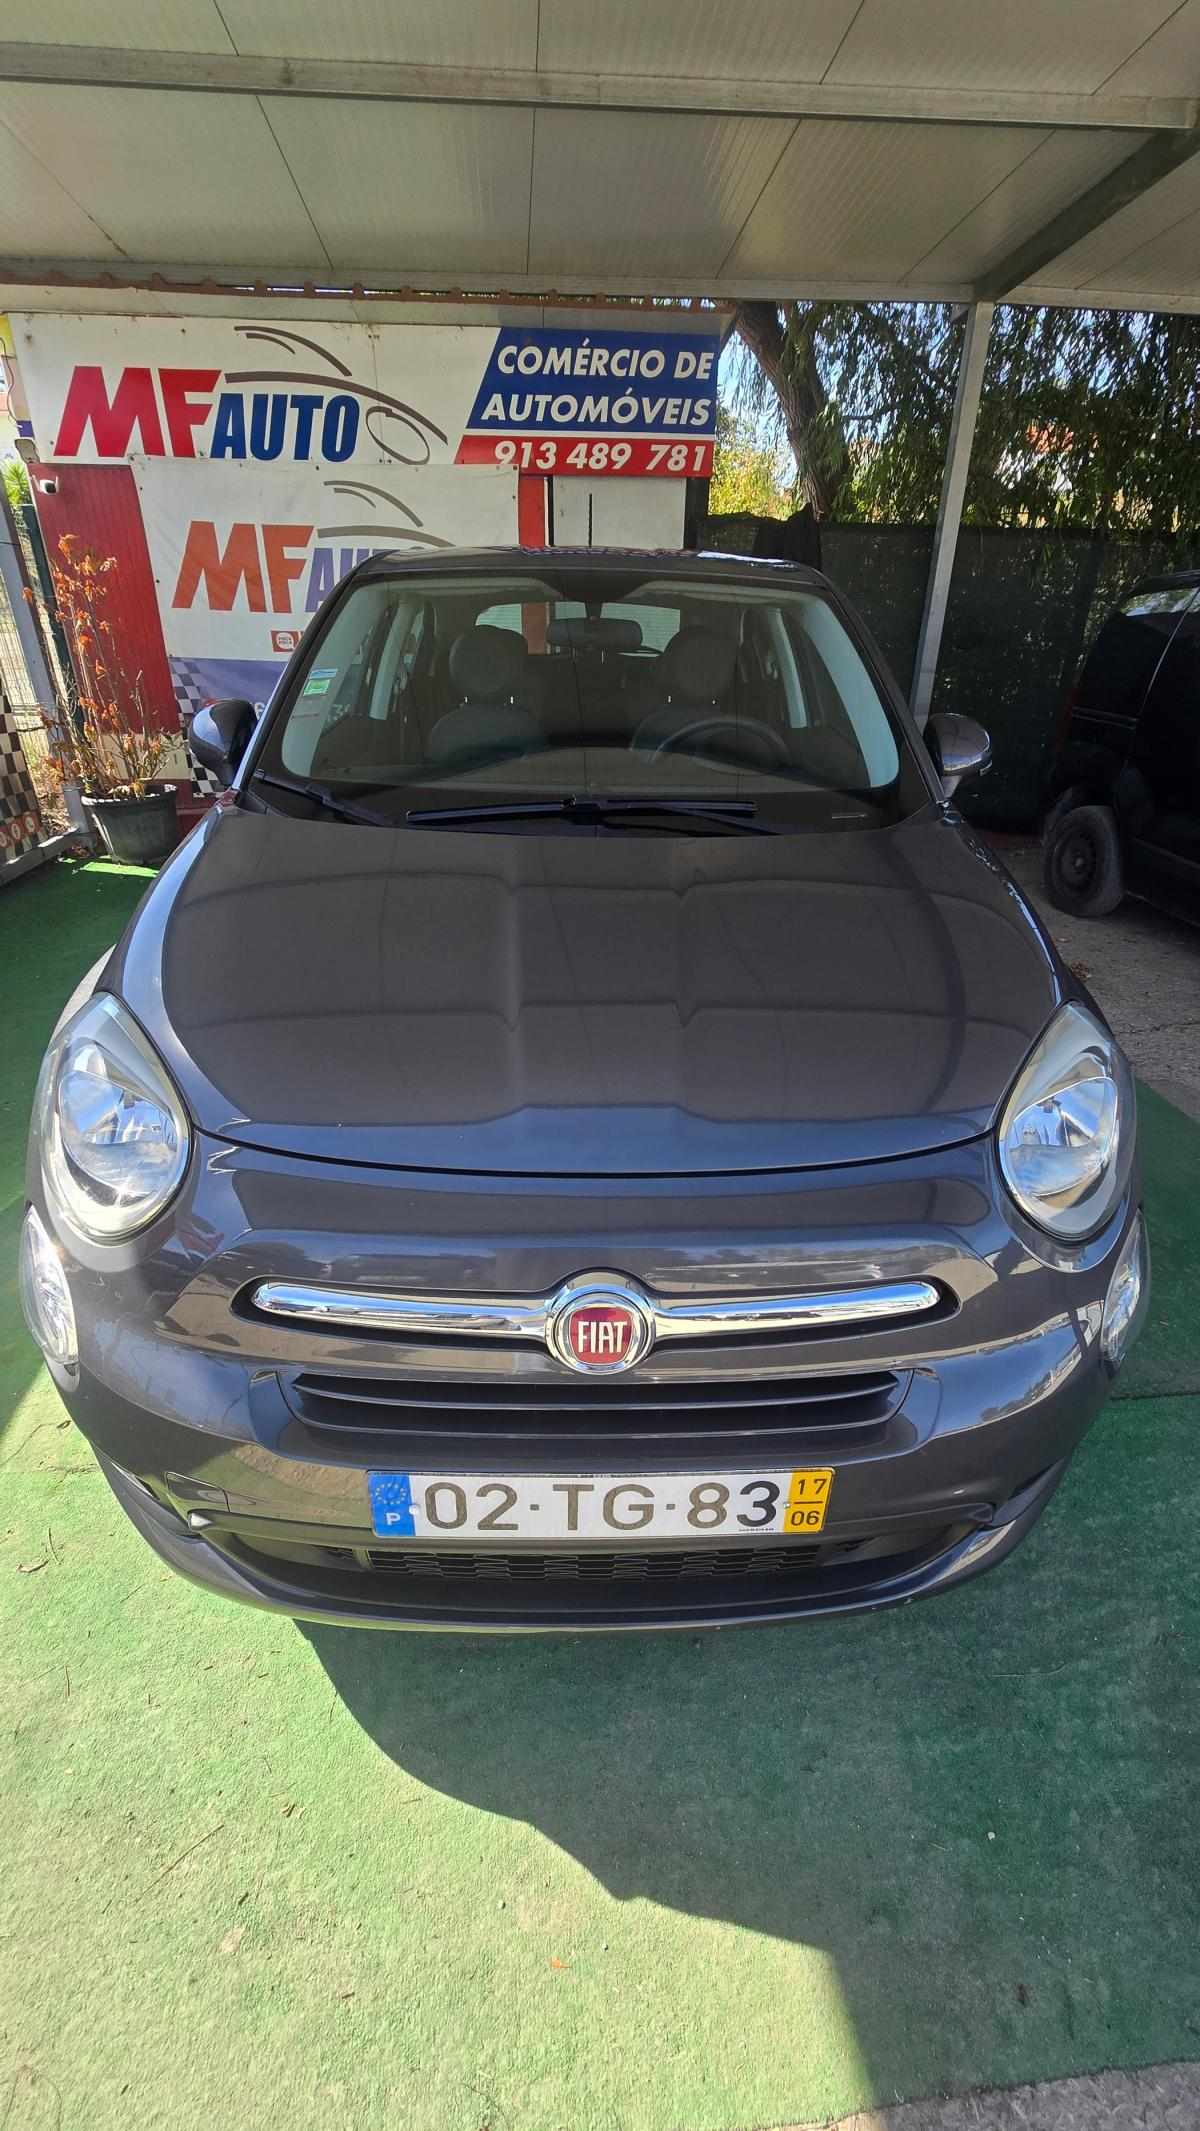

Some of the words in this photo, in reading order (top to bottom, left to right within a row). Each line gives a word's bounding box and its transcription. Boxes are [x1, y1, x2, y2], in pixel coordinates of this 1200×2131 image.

[498, 338, 665, 379] COMÉRCIO
[673, 352, 714, 379] DE
[481, 387, 711, 426] AUTOMÓVEIS
[494, 441, 557, 469] 913
[566, 443, 632, 471] 489
[645, 445, 706, 472] 781
[577, 1321, 628, 1354] FIAT
[798, 1478, 828, 1495] 17
[385, 1512, 401, 1526] P
[790, 1510, 820, 1526] 06
